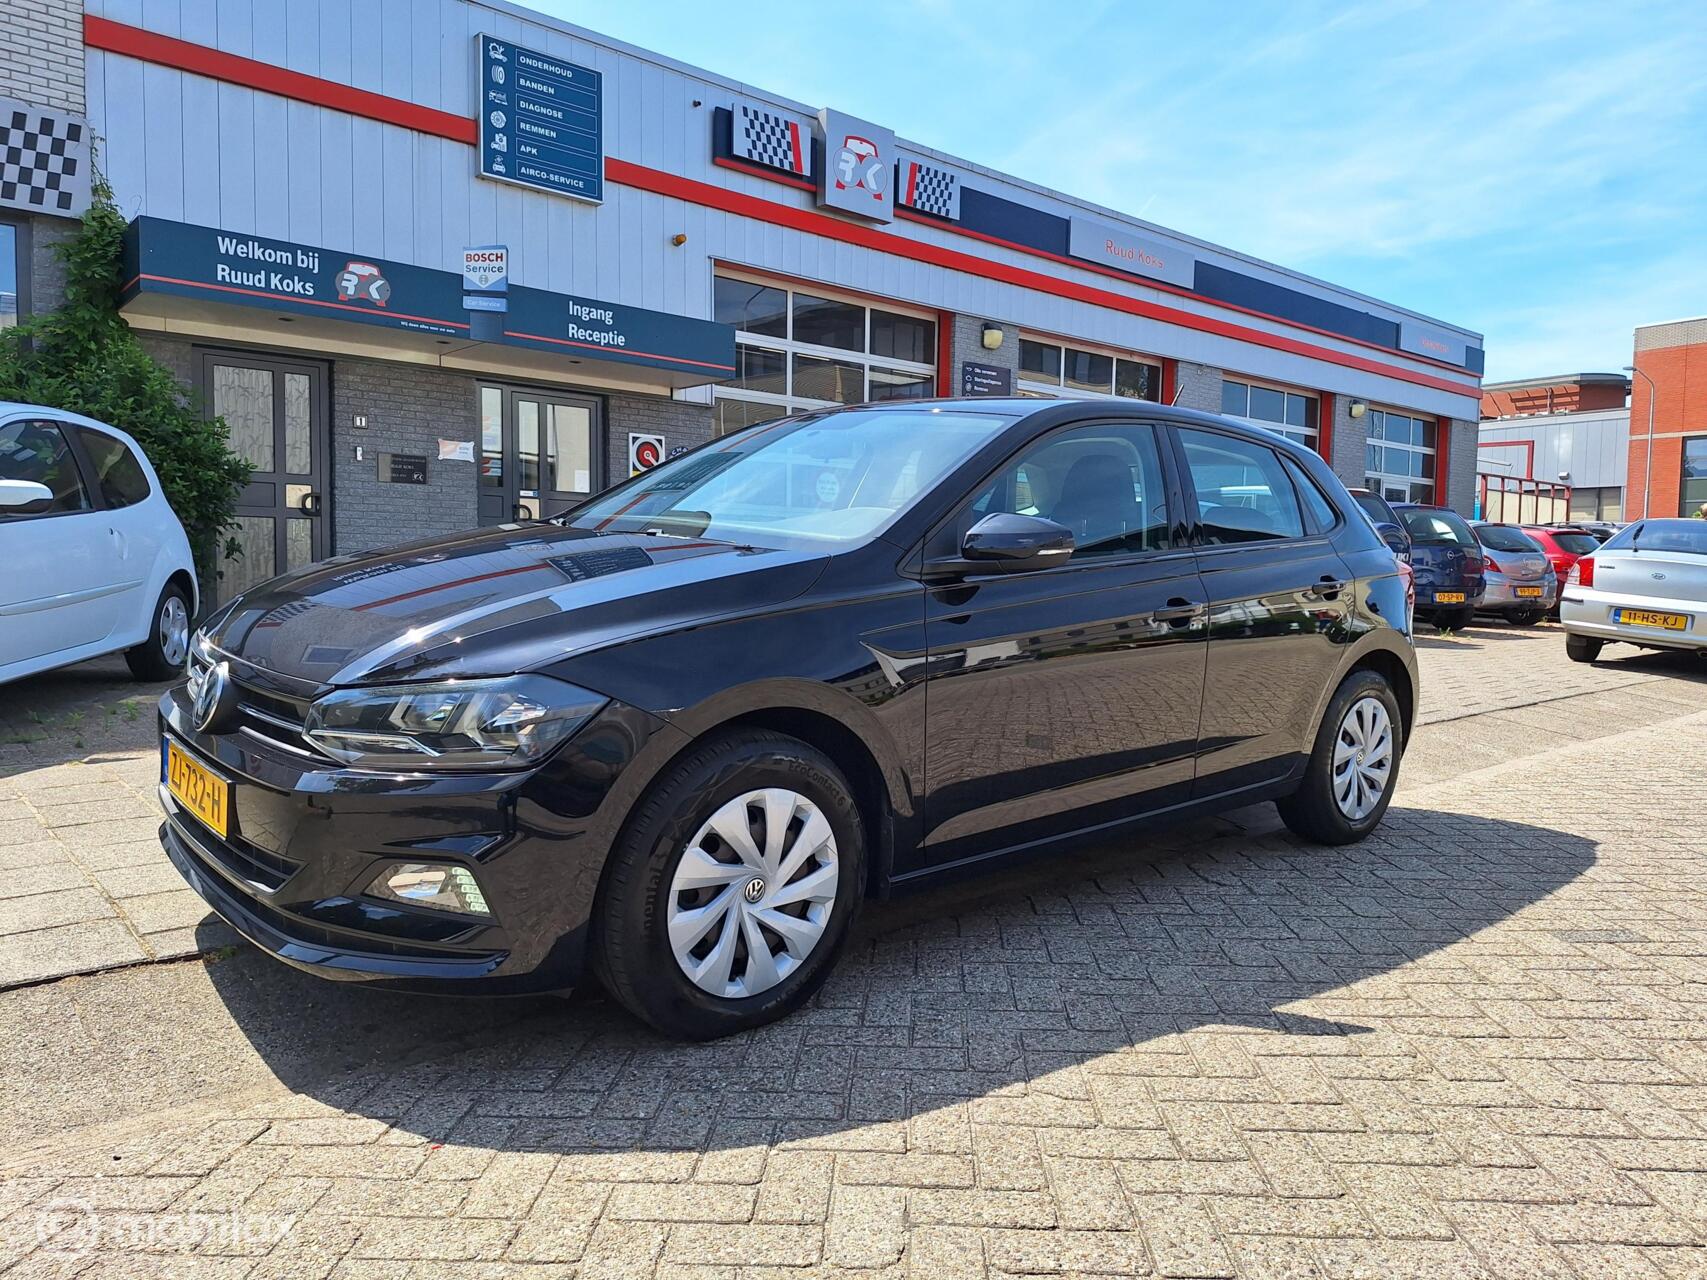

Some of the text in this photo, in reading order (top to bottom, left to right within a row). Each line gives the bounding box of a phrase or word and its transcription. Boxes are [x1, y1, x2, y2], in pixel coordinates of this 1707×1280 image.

[519, 56, 573, 78] ONDERHOUD
[519, 79, 555, 95] BANDEN
[519, 100, 564, 119] DIAGNOSE
[520, 121, 557, 139] REMMEN
[520, 144, 538, 155] APK
[520, 166, 585, 189] AIRCO-SERVICE
[217, 236, 319, 274] Welkom bij
[465, 253, 503, 263] BOSCH
[1105, 239, 1165, 269] Ruud Koks
[465, 263, 504, 273] Service
[217, 264, 315, 296] Ruud Koks
[568, 300, 613, 325] Ingang
[568, 323, 626, 346] Receptie
[1628, 612, 1678, 626] 11-HS-KJ
[789, 761, 846, 806] EcoContact 6
